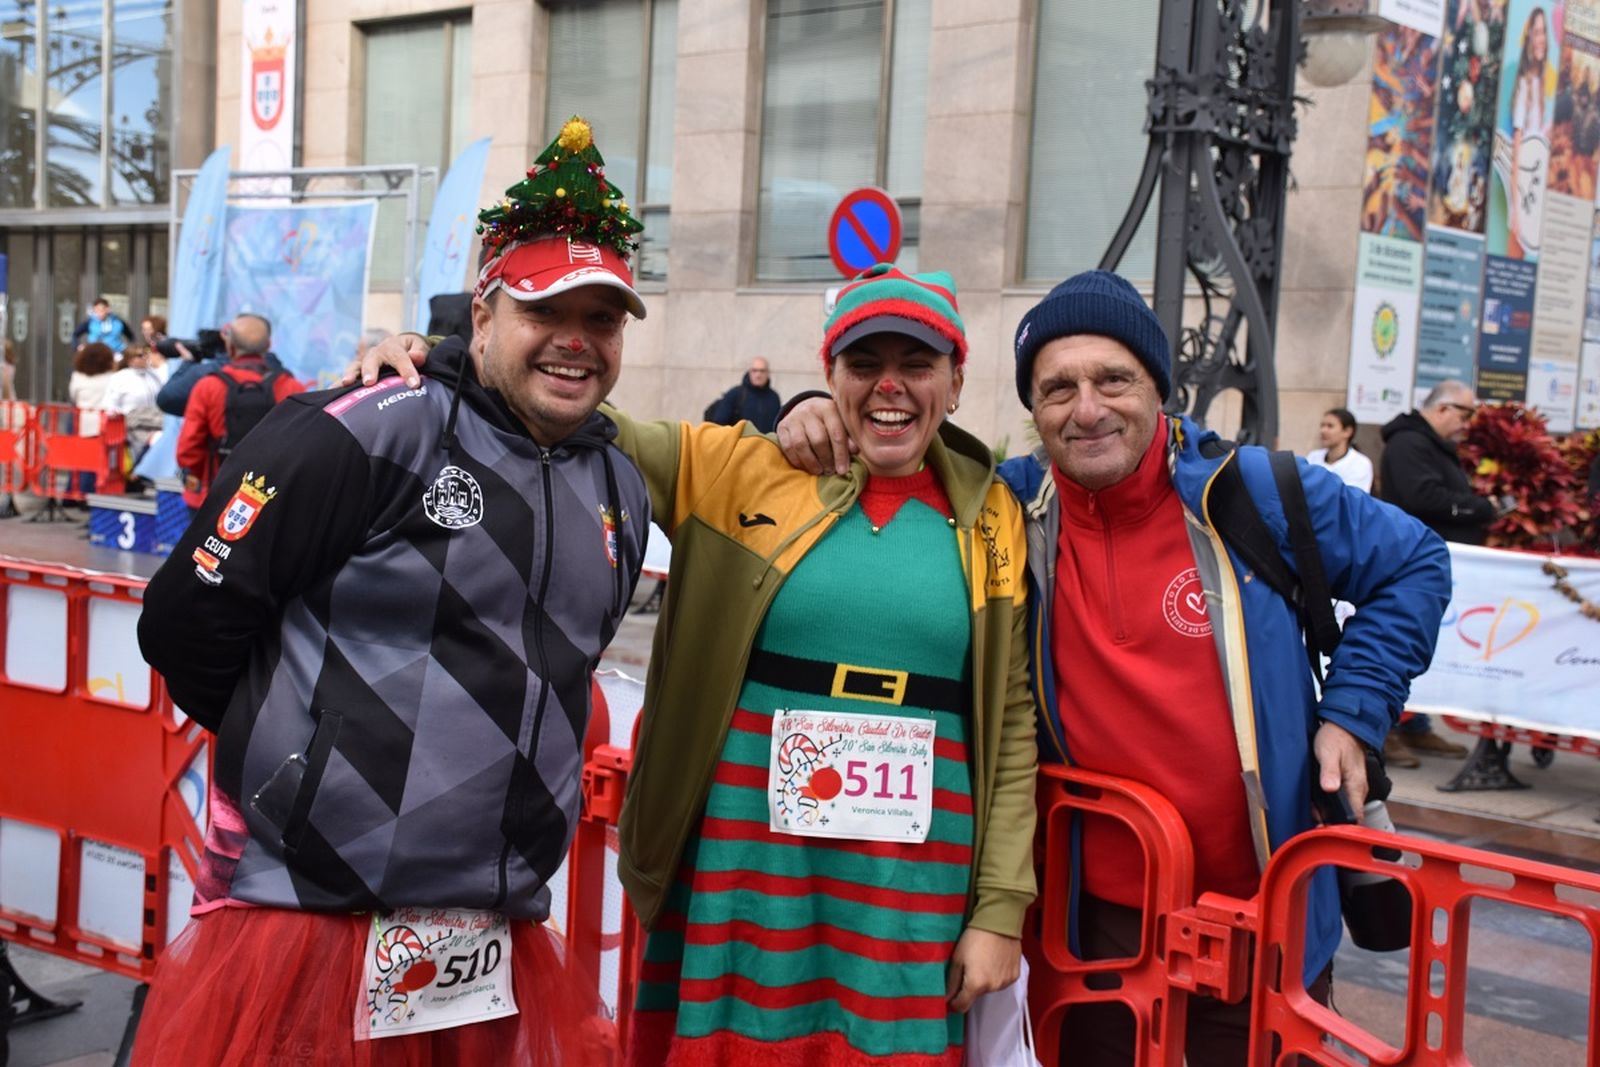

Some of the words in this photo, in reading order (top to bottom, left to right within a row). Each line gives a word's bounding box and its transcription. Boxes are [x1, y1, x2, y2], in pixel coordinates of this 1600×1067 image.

[117, 512, 136, 549] 3
[204, 535, 232, 560] CEUTA
[796, 715, 814, 731] San
[817, 717, 855, 734] Silvestre
[858, 720, 892, 737] Ciudad
[858, 740, 875, 754] San
[877, 741, 908, 755] Silvestre
[844, 760, 918, 800] 511
[435, 939, 502, 989] 510
